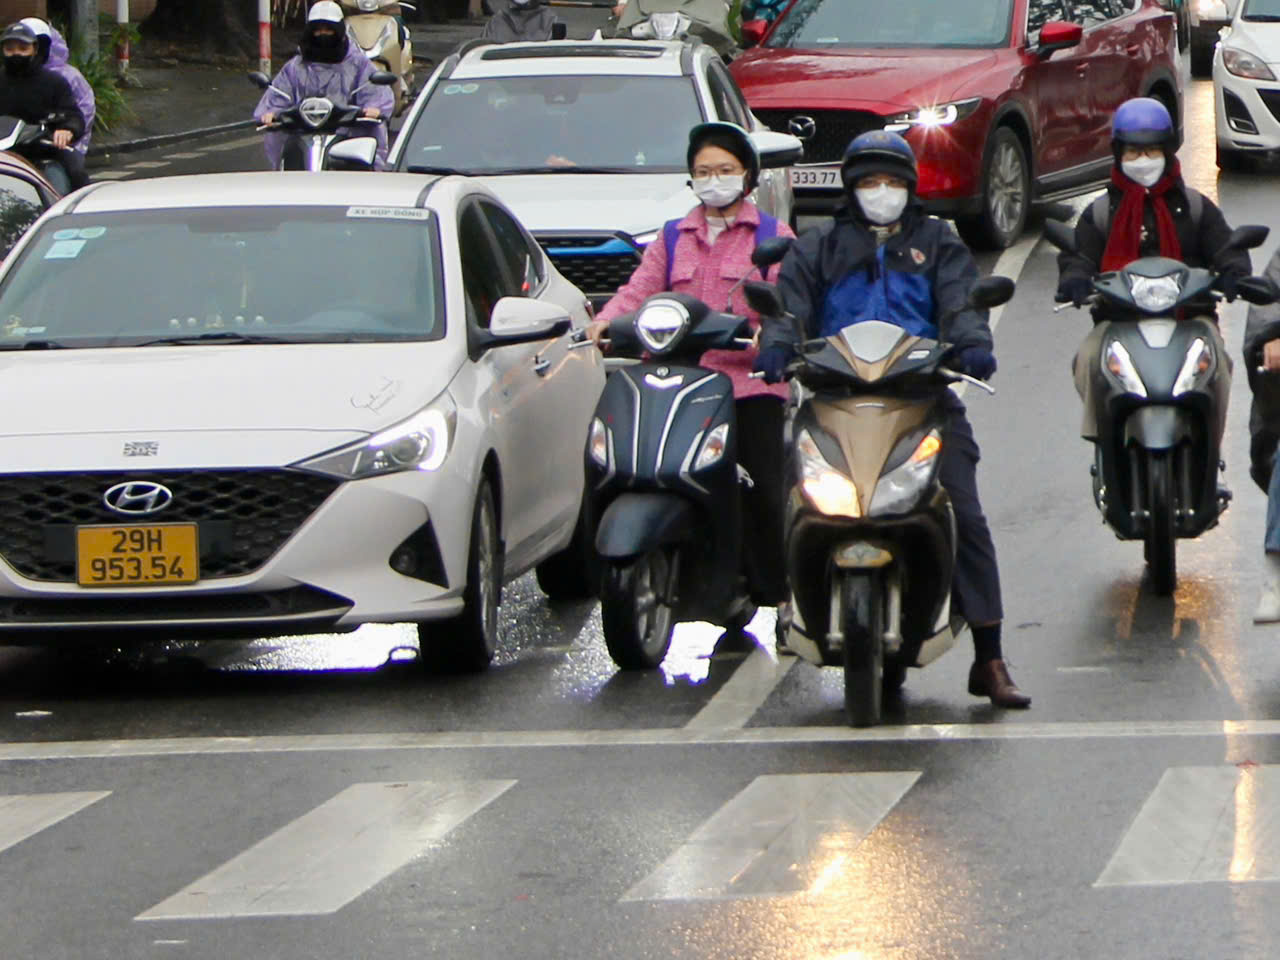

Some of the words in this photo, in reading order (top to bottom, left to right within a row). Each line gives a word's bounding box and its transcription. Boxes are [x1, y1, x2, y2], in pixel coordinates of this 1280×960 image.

[792, 171, 836, 185] 333.77
[111, 529, 162, 553] 29H
[91, 555, 185, 581] 953.54
